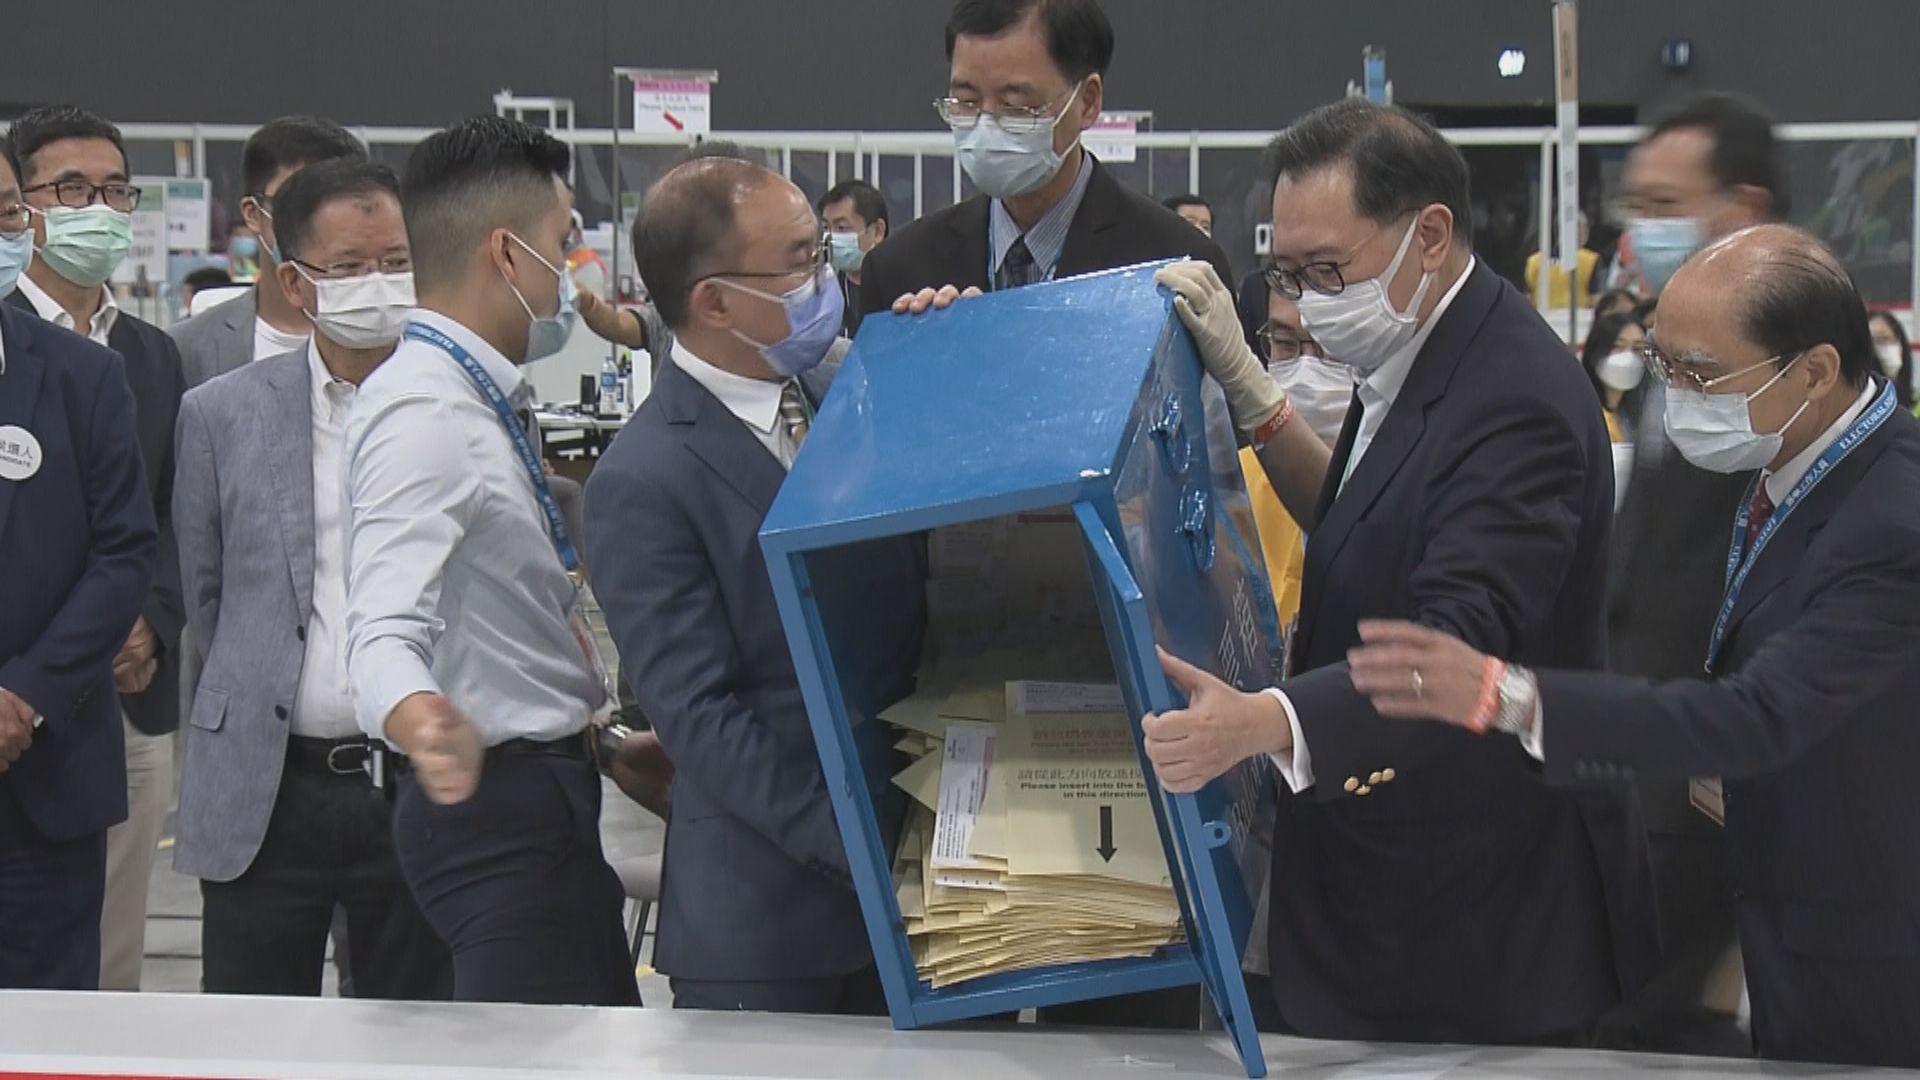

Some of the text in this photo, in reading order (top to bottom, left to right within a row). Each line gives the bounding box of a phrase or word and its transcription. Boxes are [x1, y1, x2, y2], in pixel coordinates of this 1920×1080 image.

[1020, 782, 1057, 790] Please
[1059, 782, 1091, 790] insert
[1093, 782, 1115, 790] into
[1116, 782, 1132, 790] the
[1063, 790, 1147, 799] in this direction
